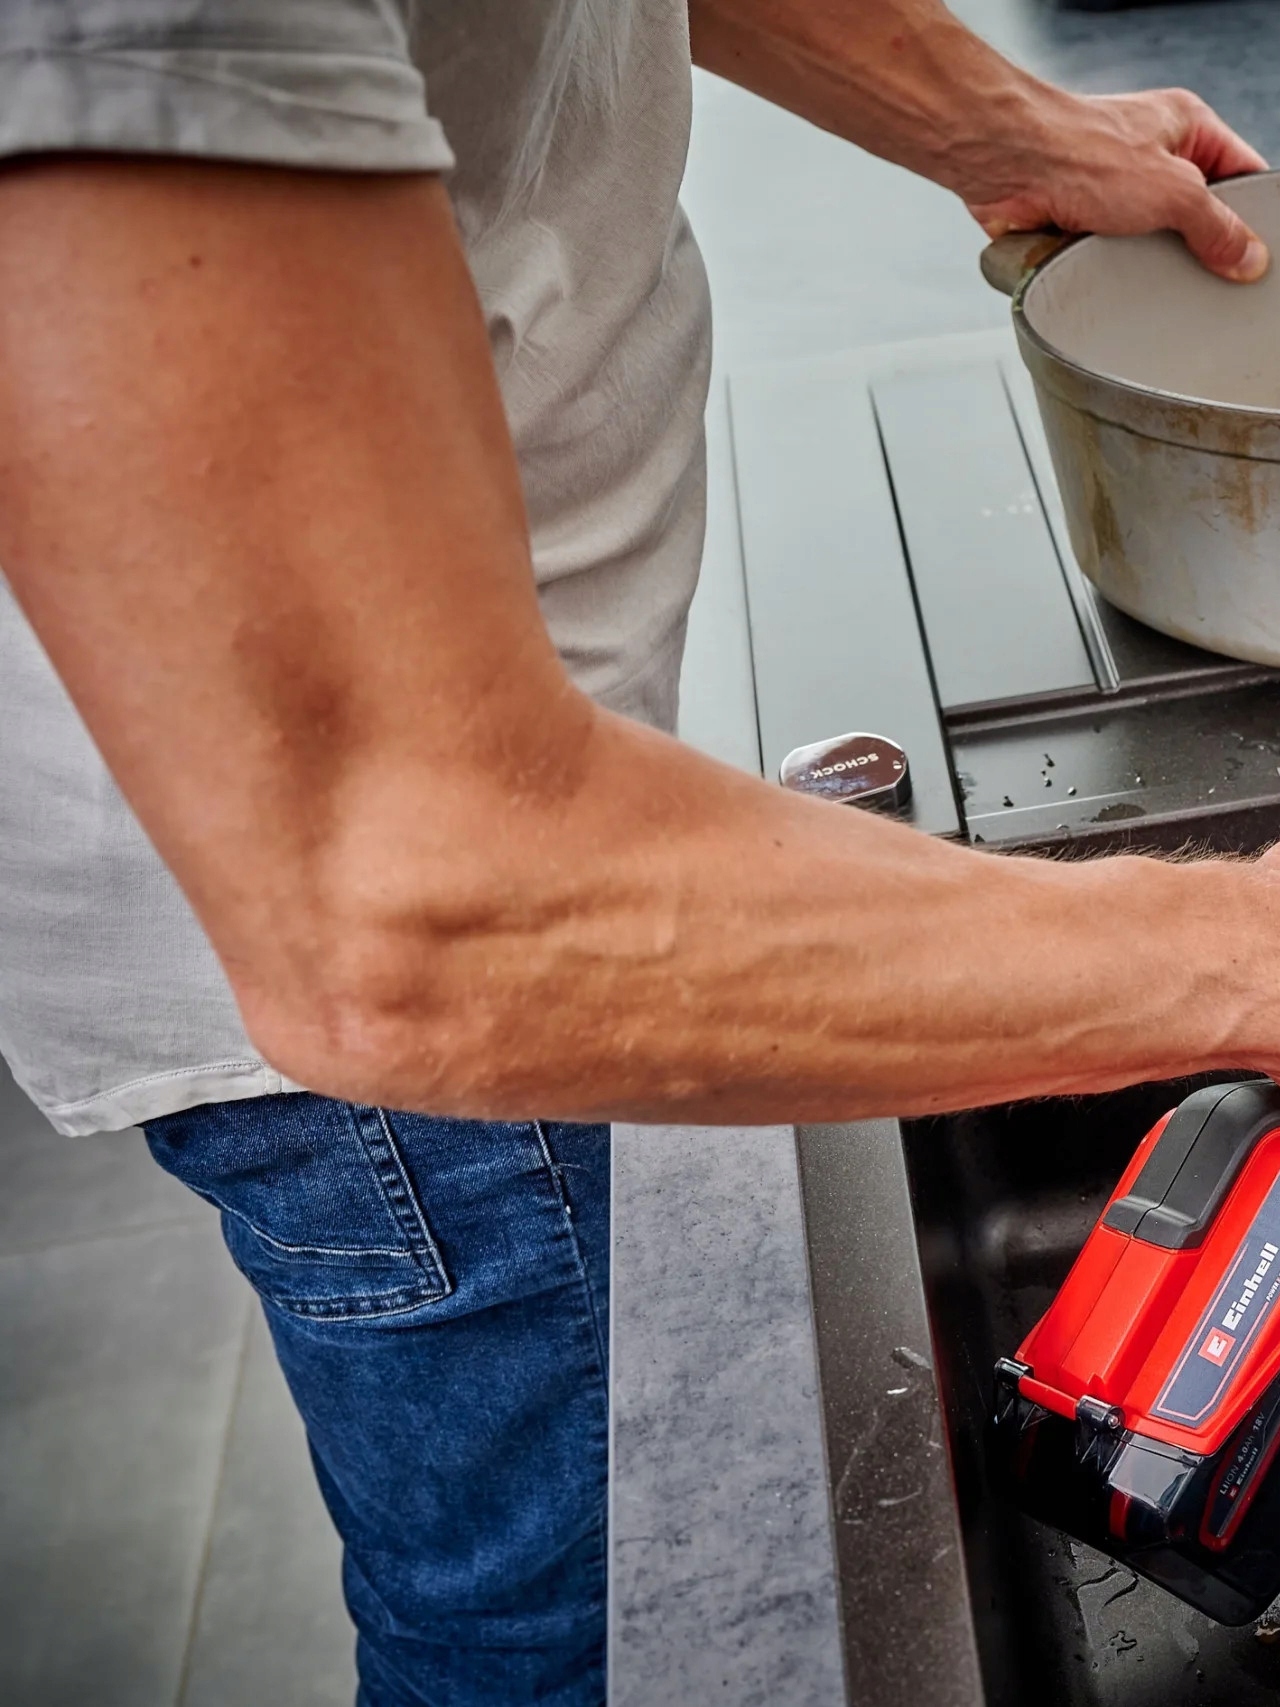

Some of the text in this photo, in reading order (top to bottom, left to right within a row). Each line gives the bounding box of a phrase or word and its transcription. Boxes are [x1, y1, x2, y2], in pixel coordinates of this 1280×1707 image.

[810, 753, 879, 779] SCHOCK
[1221, 1242, 1280, 1331] Einhell
[1266, 1281, 1280, 1302] POWER
[1252, 1411, 1266, 1431] 18V
